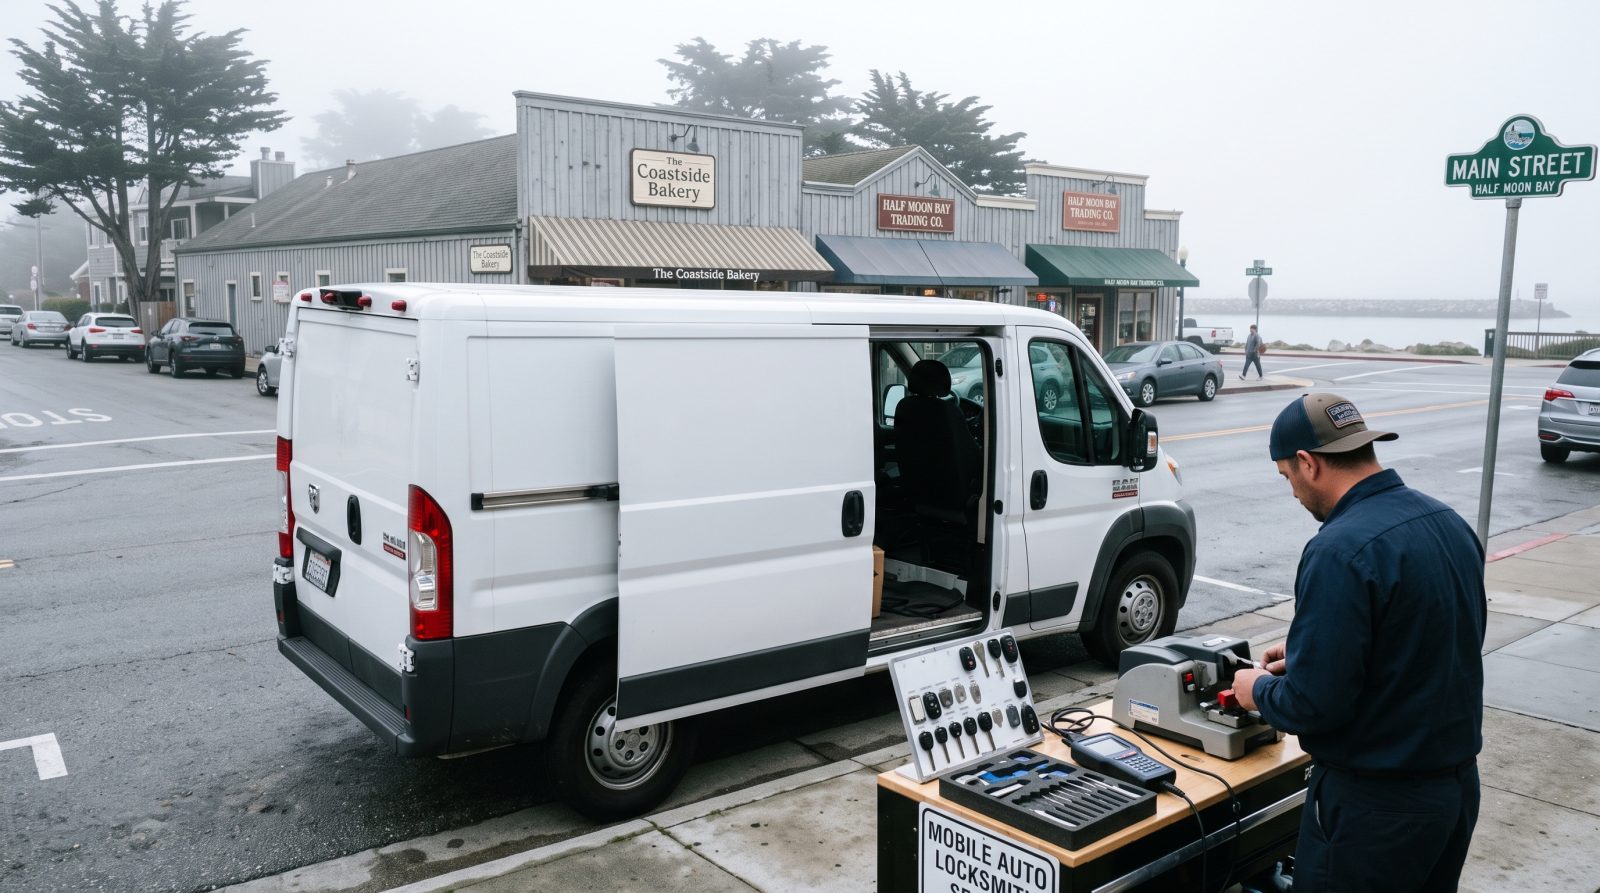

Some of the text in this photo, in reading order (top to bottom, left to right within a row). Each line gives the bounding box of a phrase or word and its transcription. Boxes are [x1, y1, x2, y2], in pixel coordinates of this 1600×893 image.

[666, 156, 683, 166] The
[1452, 152, 1586, 180] MAIN STREET
[637, 163, 711, 183] Coastside
[648, 181, 701, 203] Bakery
[1475, 180, 1556, 195] HALF MOON BAY
[883, 199, 951, 215] HALF MOON BAY
[1067, 196, 1117, 209] HALF MOON BAY
[890, 213, 944, 228] TRADING CO.
[1070, 207, 1114, 220] TRADING CO.
[473, 249, 509, 259] The Coastside
[481, 260, 500, 270] Bakery
[652, 268, 760, 283] The Coastside Bakery
[0, 408, 113, 430] STO
[928, 820, 1047, 890] MOBILE AUTO
